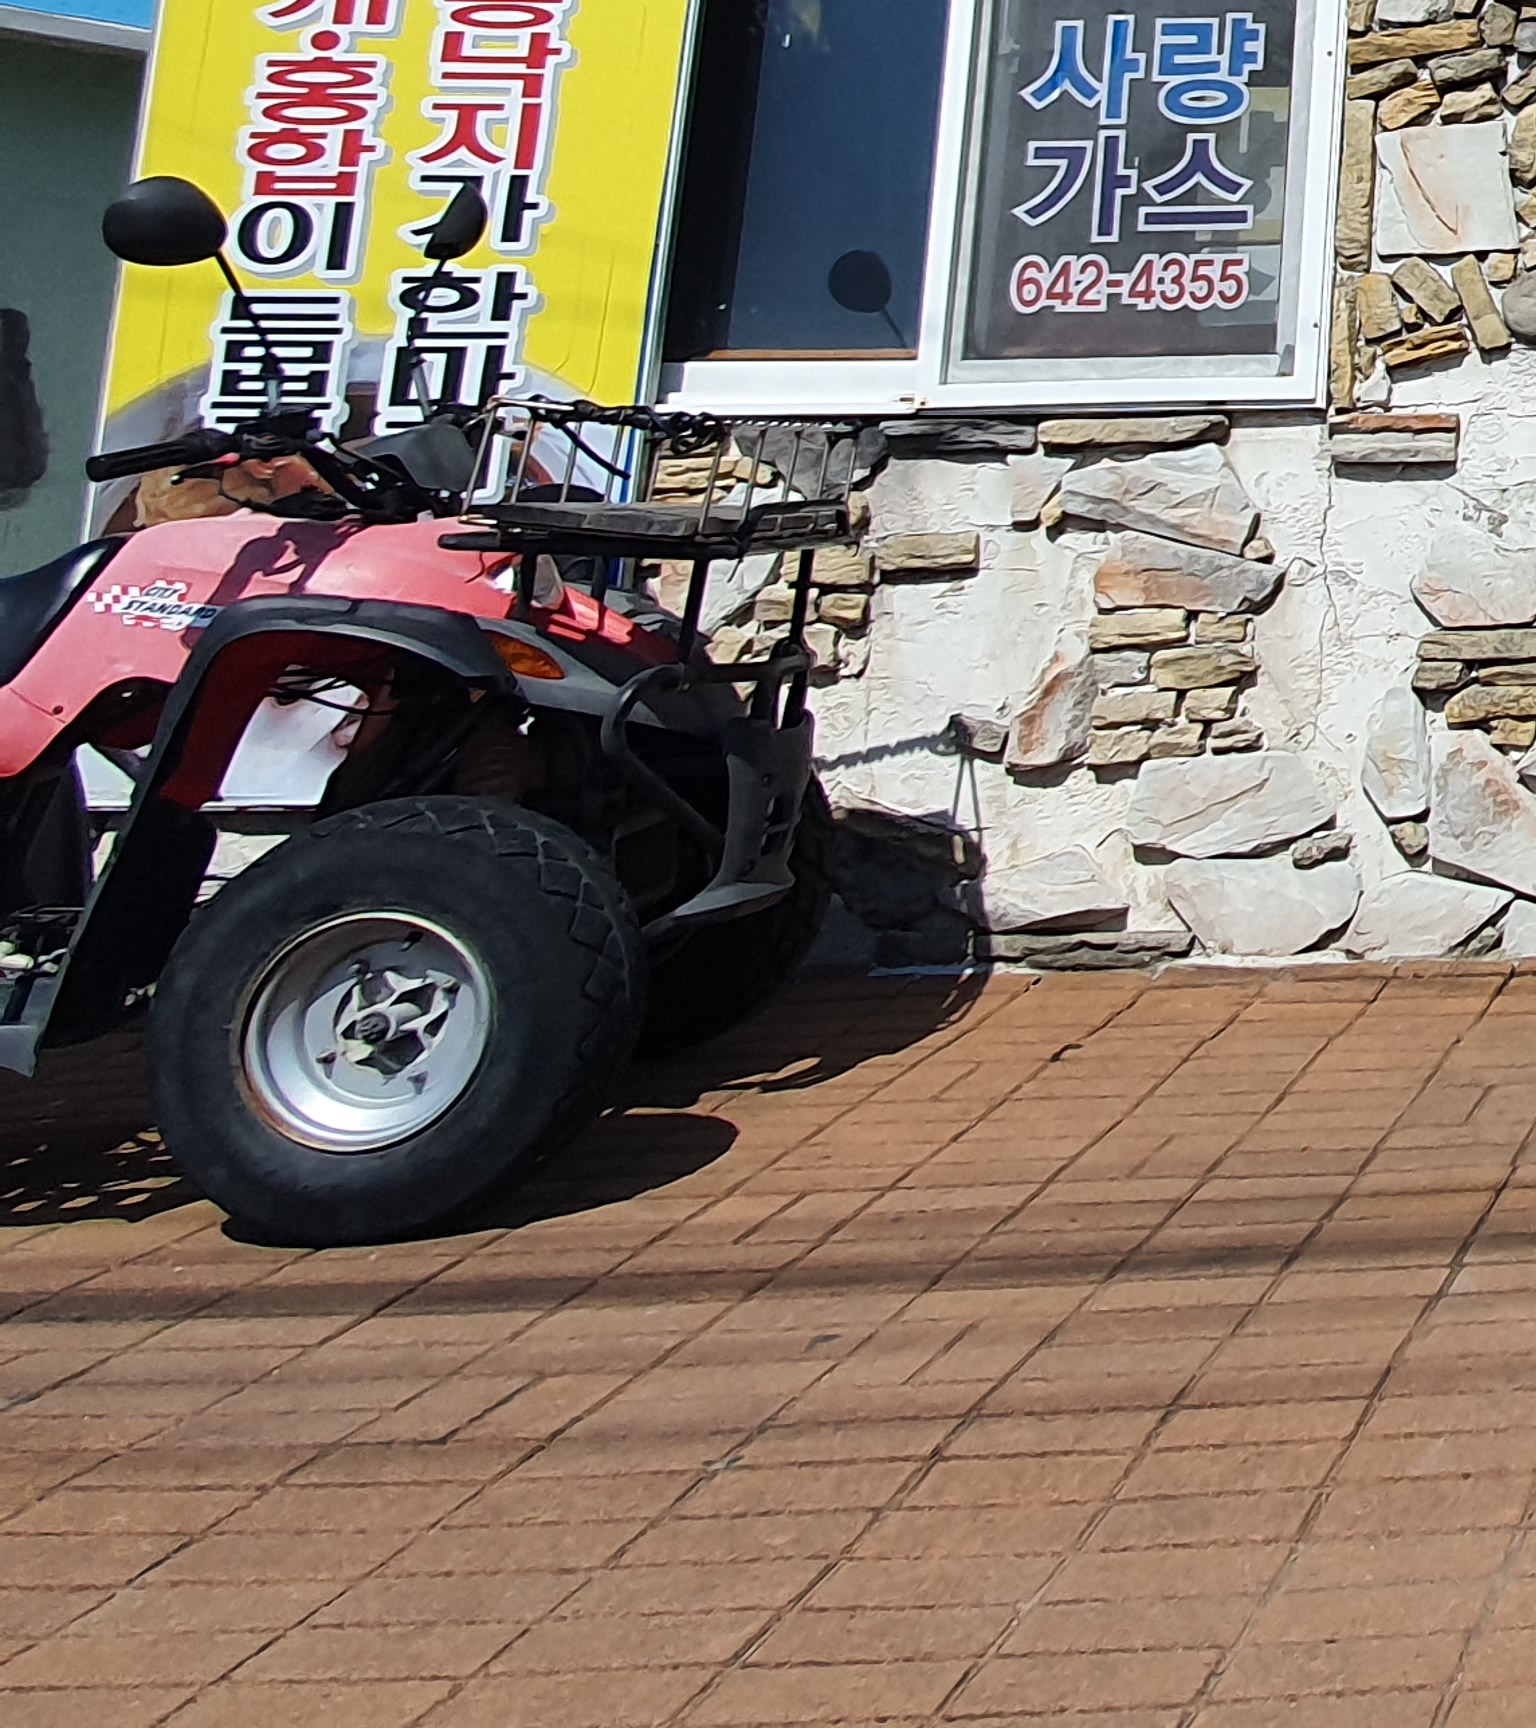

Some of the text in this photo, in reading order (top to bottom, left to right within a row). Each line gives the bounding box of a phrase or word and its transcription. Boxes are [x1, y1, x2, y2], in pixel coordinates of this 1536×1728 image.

[1019, 11, 1265, 127] 사량
[1010, 130, 1254, 243] 가스
[1011, 252, 1250, 314] 642-4355
